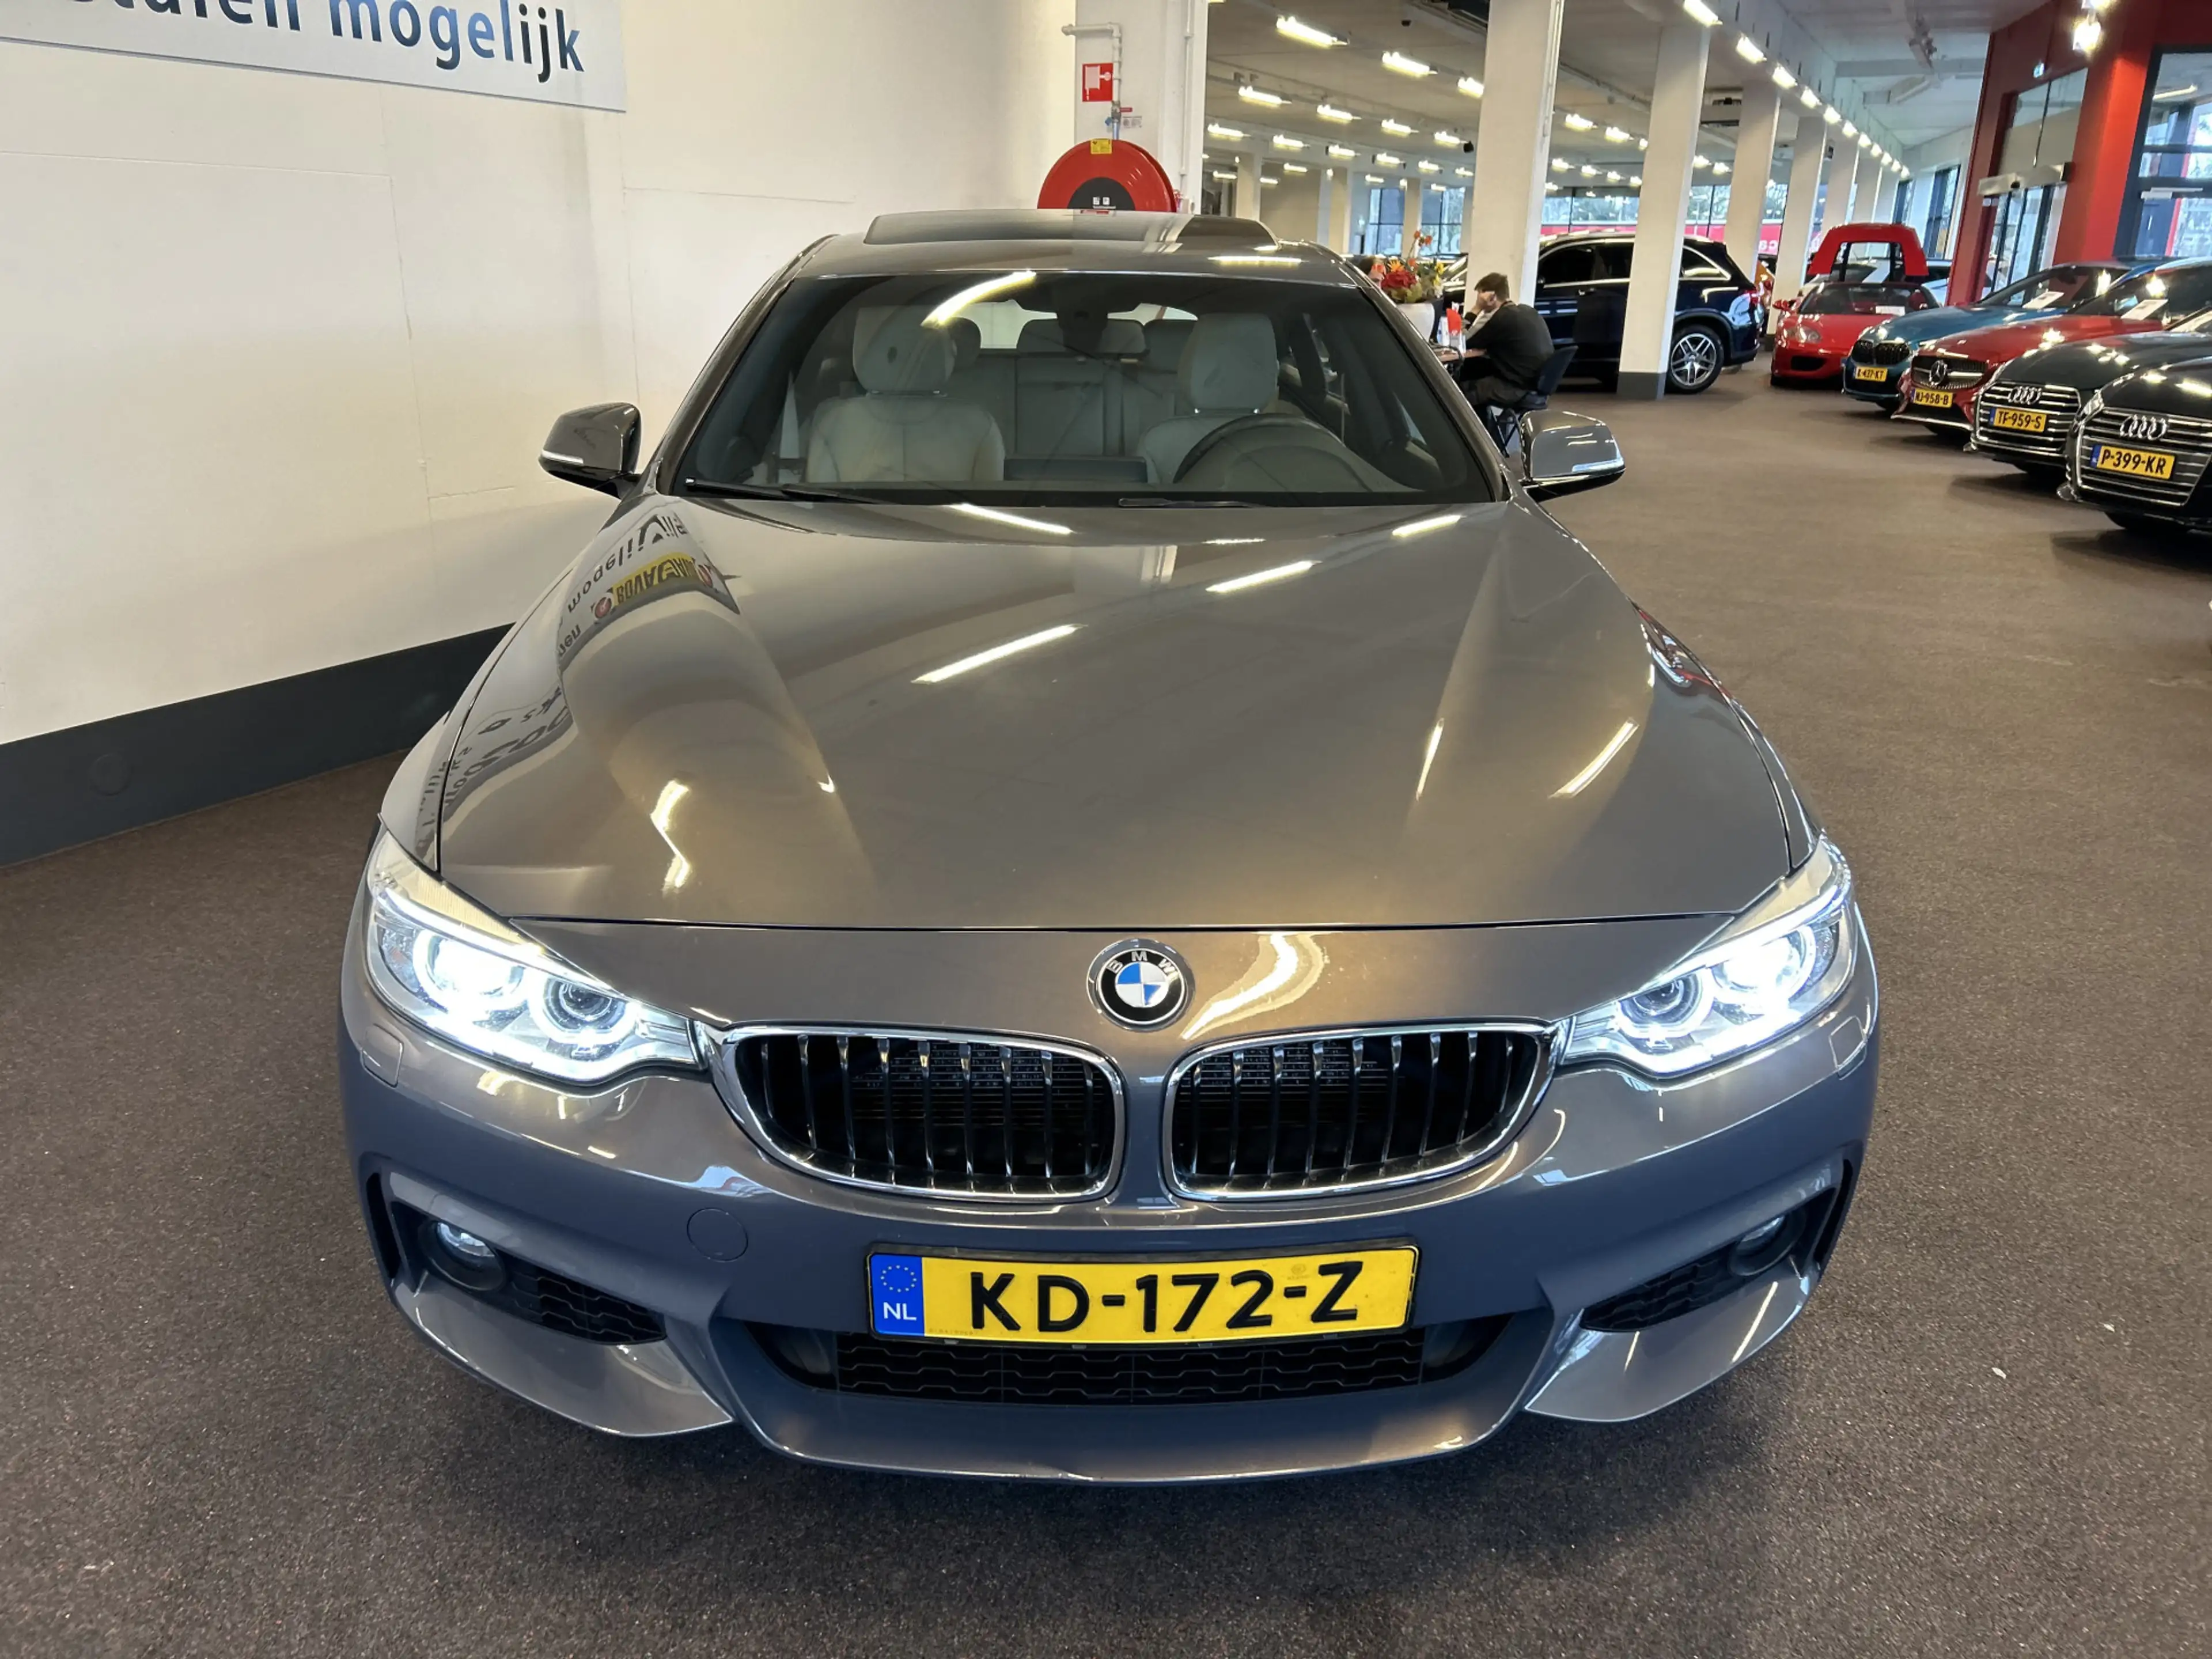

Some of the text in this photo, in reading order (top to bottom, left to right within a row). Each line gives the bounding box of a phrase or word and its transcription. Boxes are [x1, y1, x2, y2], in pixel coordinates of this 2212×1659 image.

[329, 0, 585, 84] mogelijk
[1998, 411, 2042, 429] TF-959-S
[2101, 449, 2166, 475] P-399-KR
[1107, 950, 1180, 980] BMW
[883, 1301, 917, 1321] NL
[971, 1261, 1363, 1333] KD-172-Z
